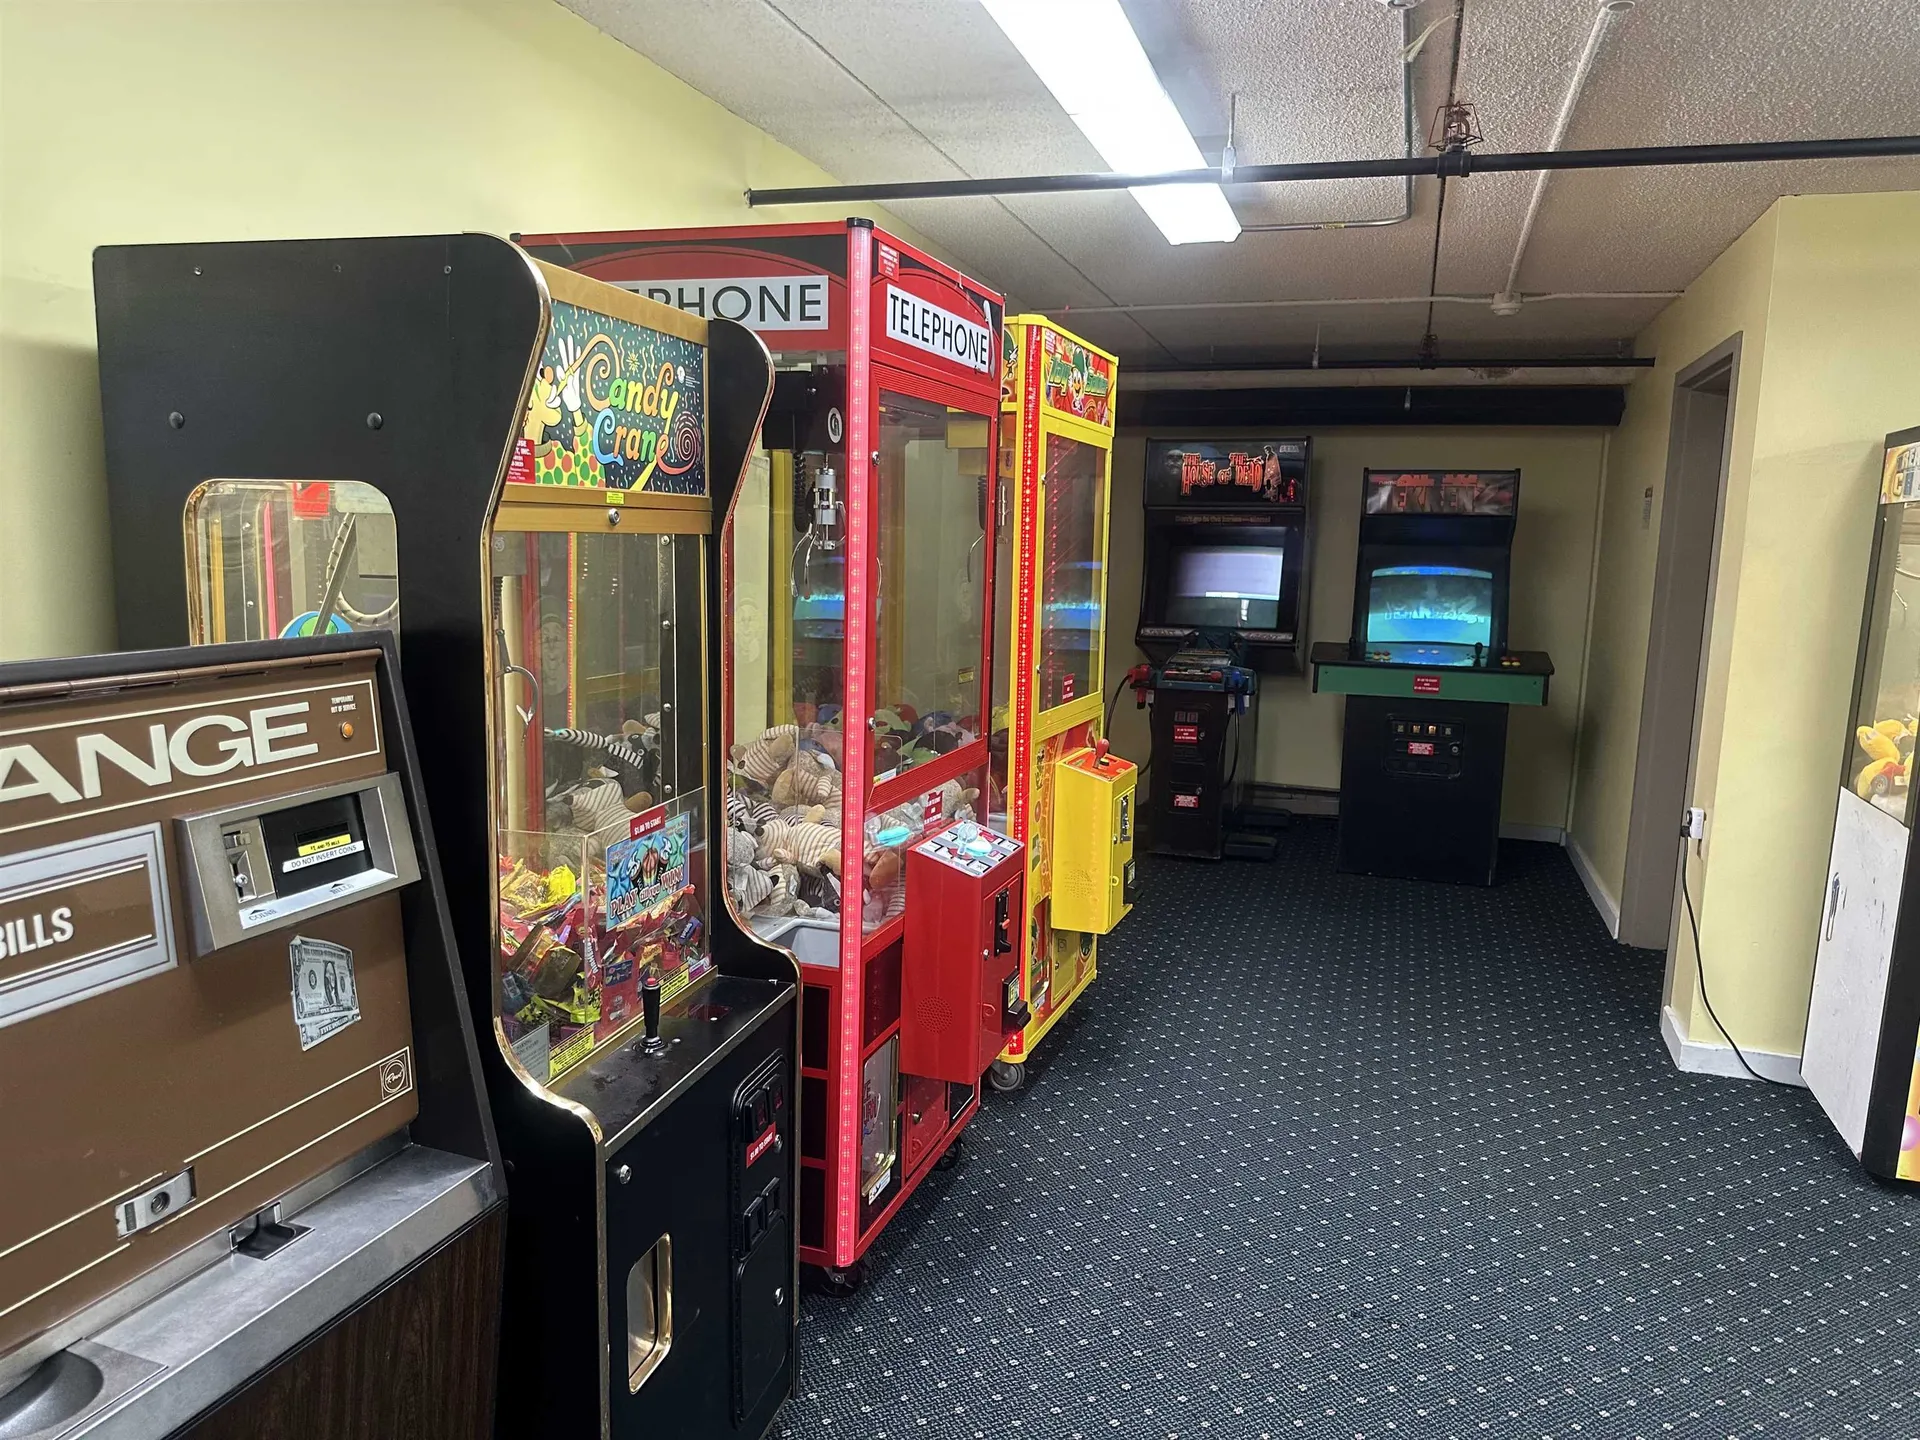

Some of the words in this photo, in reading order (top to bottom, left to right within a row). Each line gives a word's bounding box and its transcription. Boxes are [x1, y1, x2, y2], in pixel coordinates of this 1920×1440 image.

[626, 283, 822, 323] PHONE
[890, 293, 988, 366] TELEPHONE
[586, 335, 680, 434] Candy
[592, 407, 698, 475] Crane
[1183, 453, 1200, 465] THE
[1229, 453, 1247, 466] THE
[1182, 461, 1215, 494] HOUSE
[1218, 468, 1231, 484] OF
[1236, 461, 1262, 491] DEAD
[0, 701, 319, 804] ANGE
[291, 861, 301, 869] DO
[302, 857, 316, 865] NOT
[316, 850, 338, 861] INSERT
[338, 844, 358, 856] COINS
[610, 887, 639, 919] PLAY
